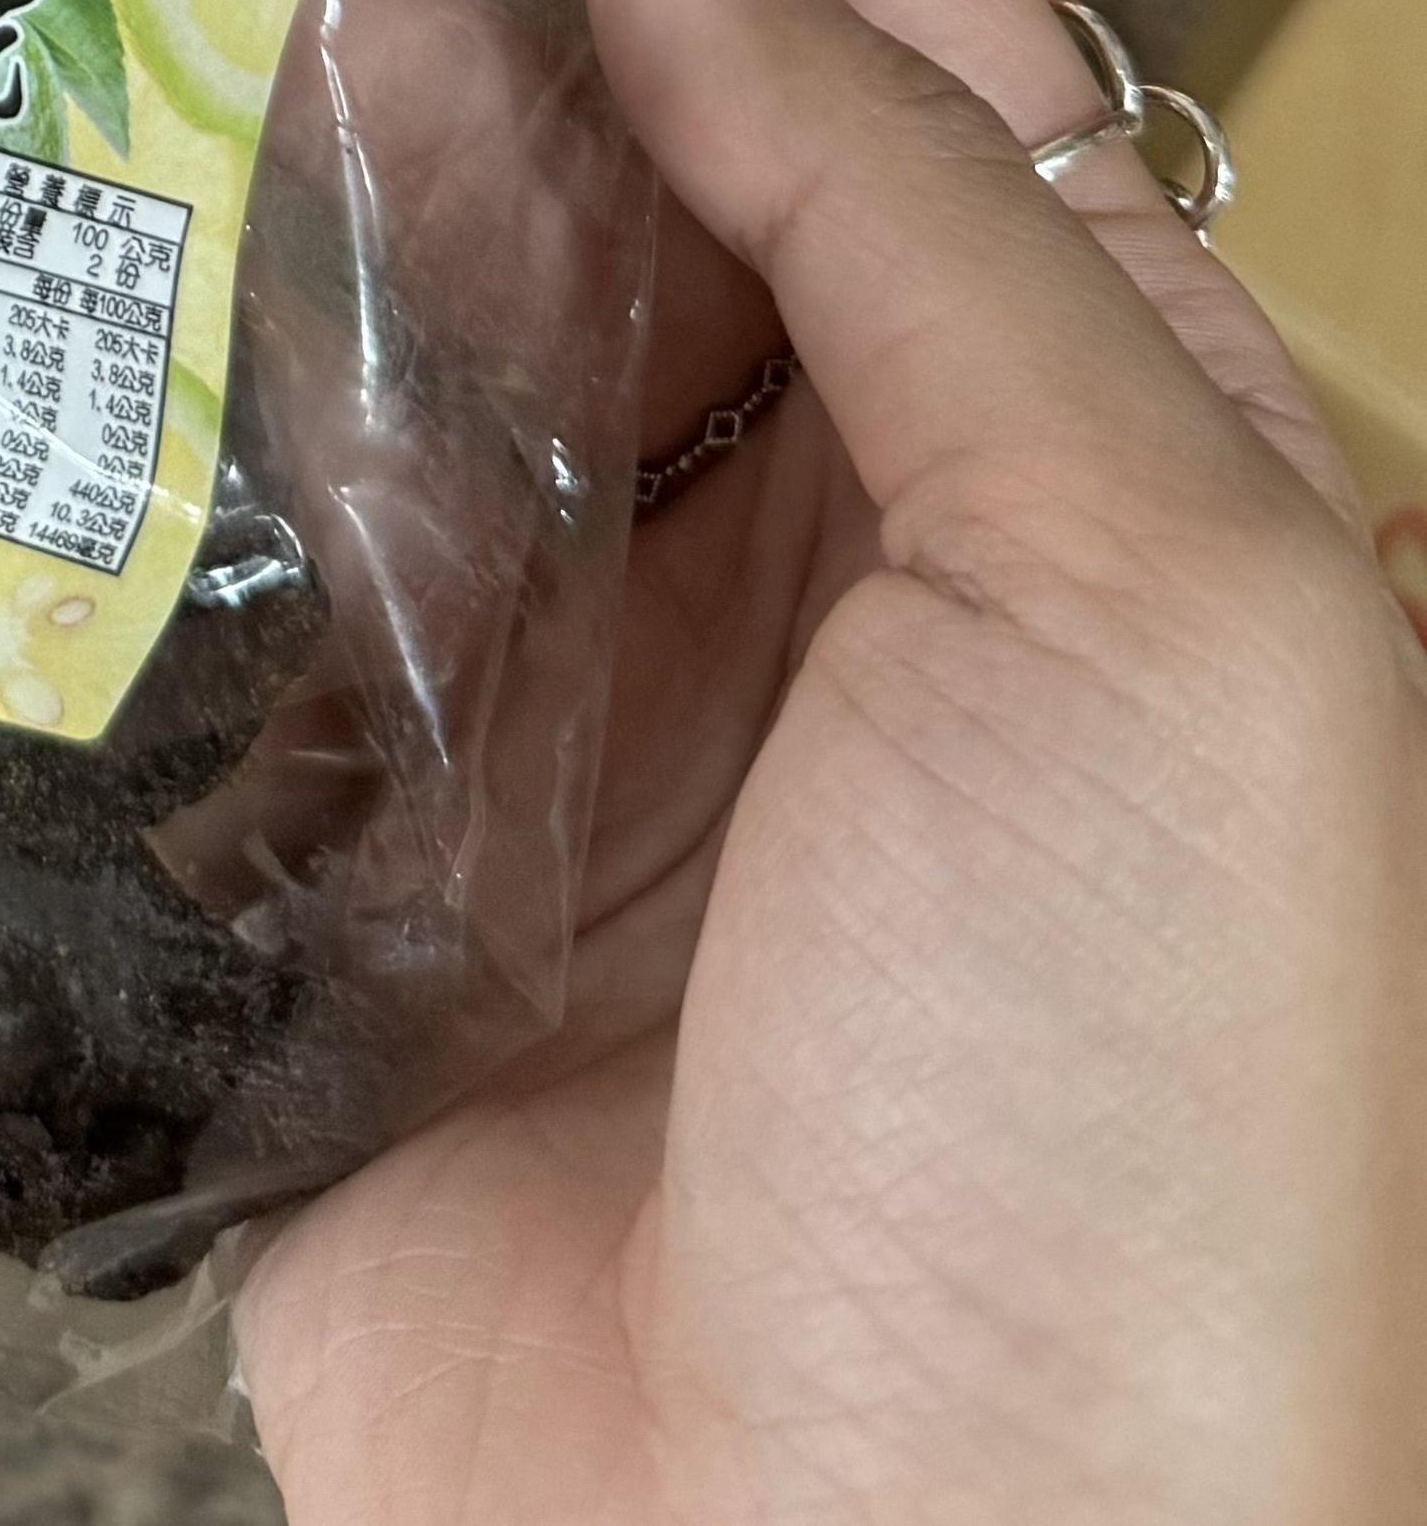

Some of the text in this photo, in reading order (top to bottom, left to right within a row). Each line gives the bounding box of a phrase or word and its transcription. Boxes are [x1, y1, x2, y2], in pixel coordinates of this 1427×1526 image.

[69, 221, 111, 253] 100
[117, 235, 176, 275] 公克
[84, 253, 105, 279] 2
[111, 261, 144, 292] 份
[29, 273, 166, 333] 每份 每100公克
[6, 305, 71, 343] 205大卡
[92, 329, 161, 368] 205大卡
[0, 333, 70, 374] 3.8公克
[88, 358, 159, 398] 3.8公克
[84, 388, 156, 429] 1.4公克
[0, 429, 52, 463] 0公克
[98, 422, 153, 459] 0公克
[67, 475, 138, 517] 440公克
[48, 498, 128, 543] 10.3公克
